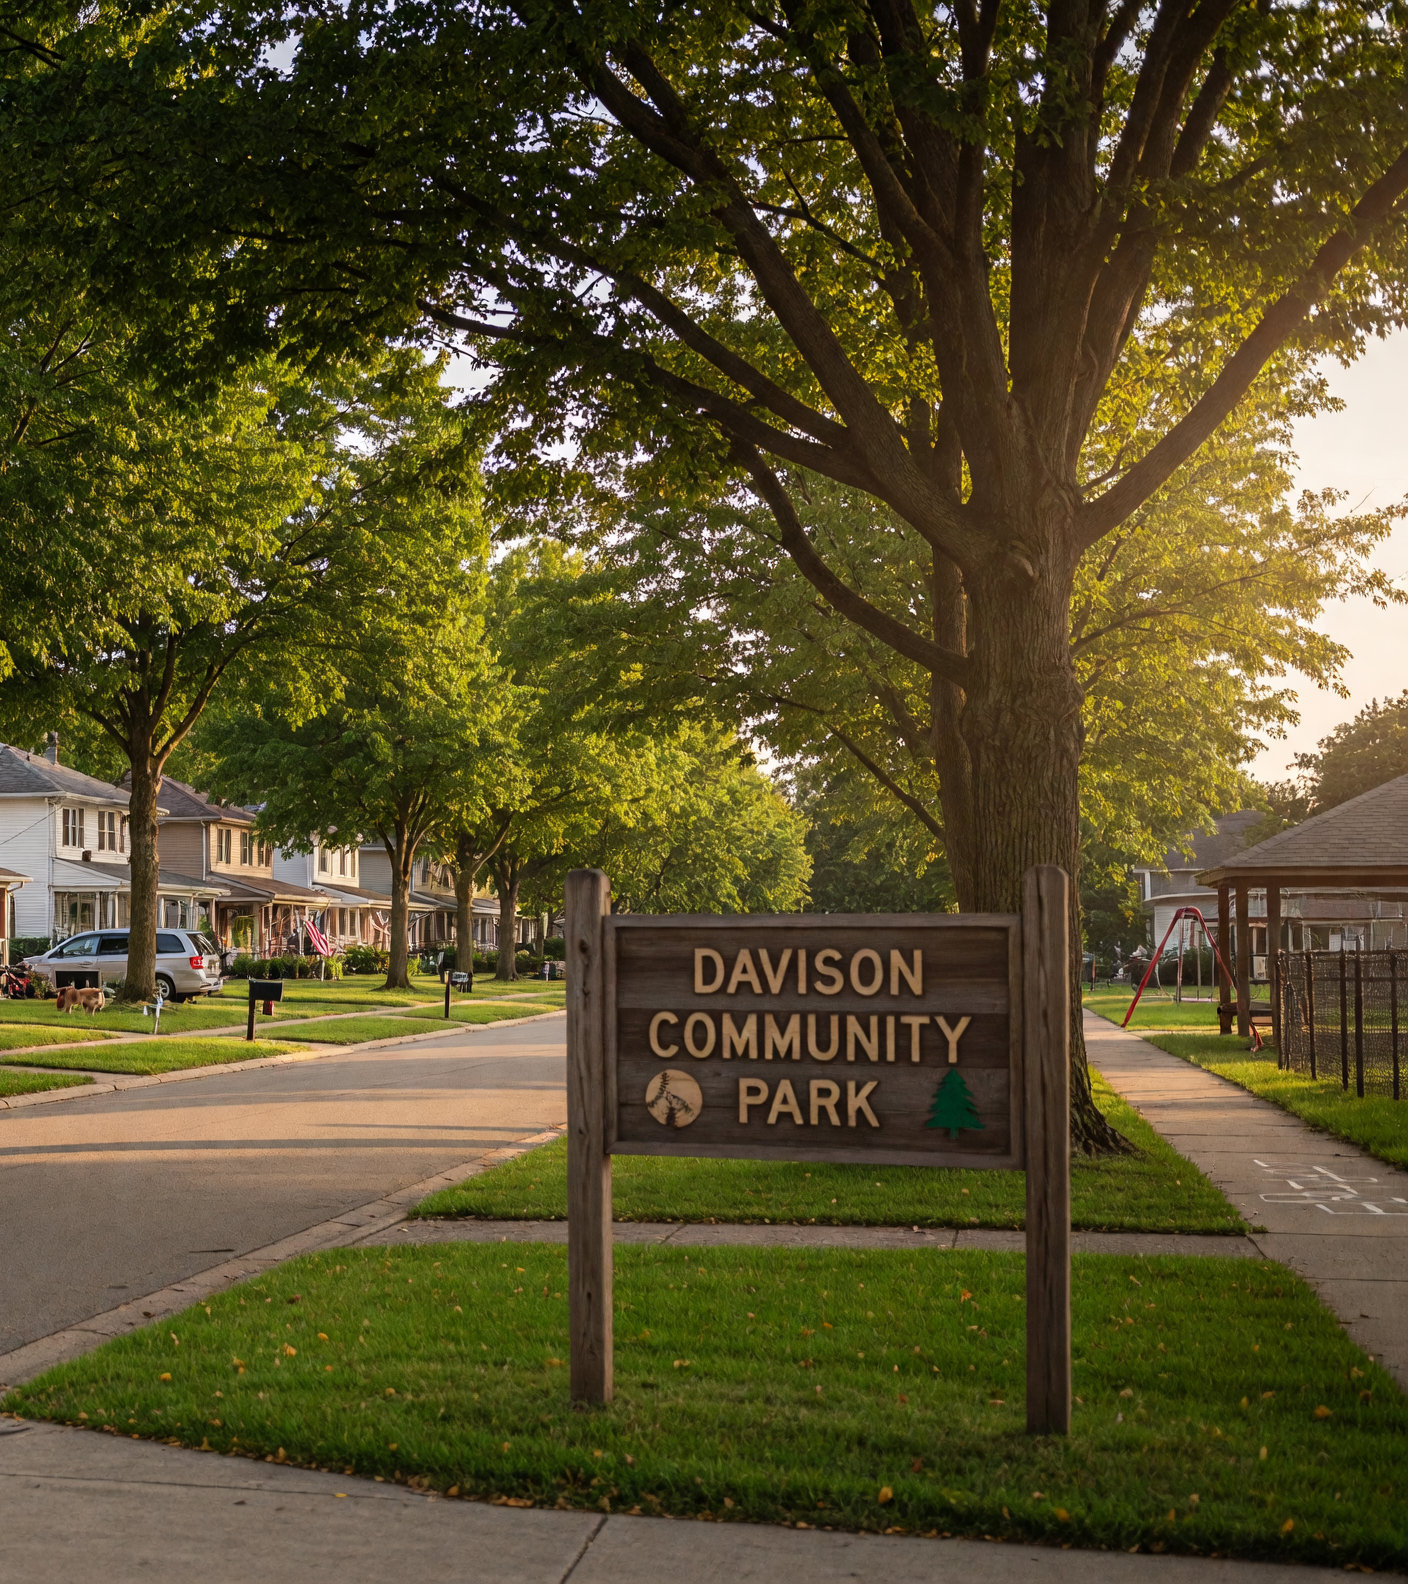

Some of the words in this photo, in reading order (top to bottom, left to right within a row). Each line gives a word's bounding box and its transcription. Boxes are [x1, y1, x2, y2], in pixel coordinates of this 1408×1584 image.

[694, 948, 923, 996] DAVISON
[649, 1011, 972, 1063] COMMUNITY
[739, 1077, 880, 1128] PARK
